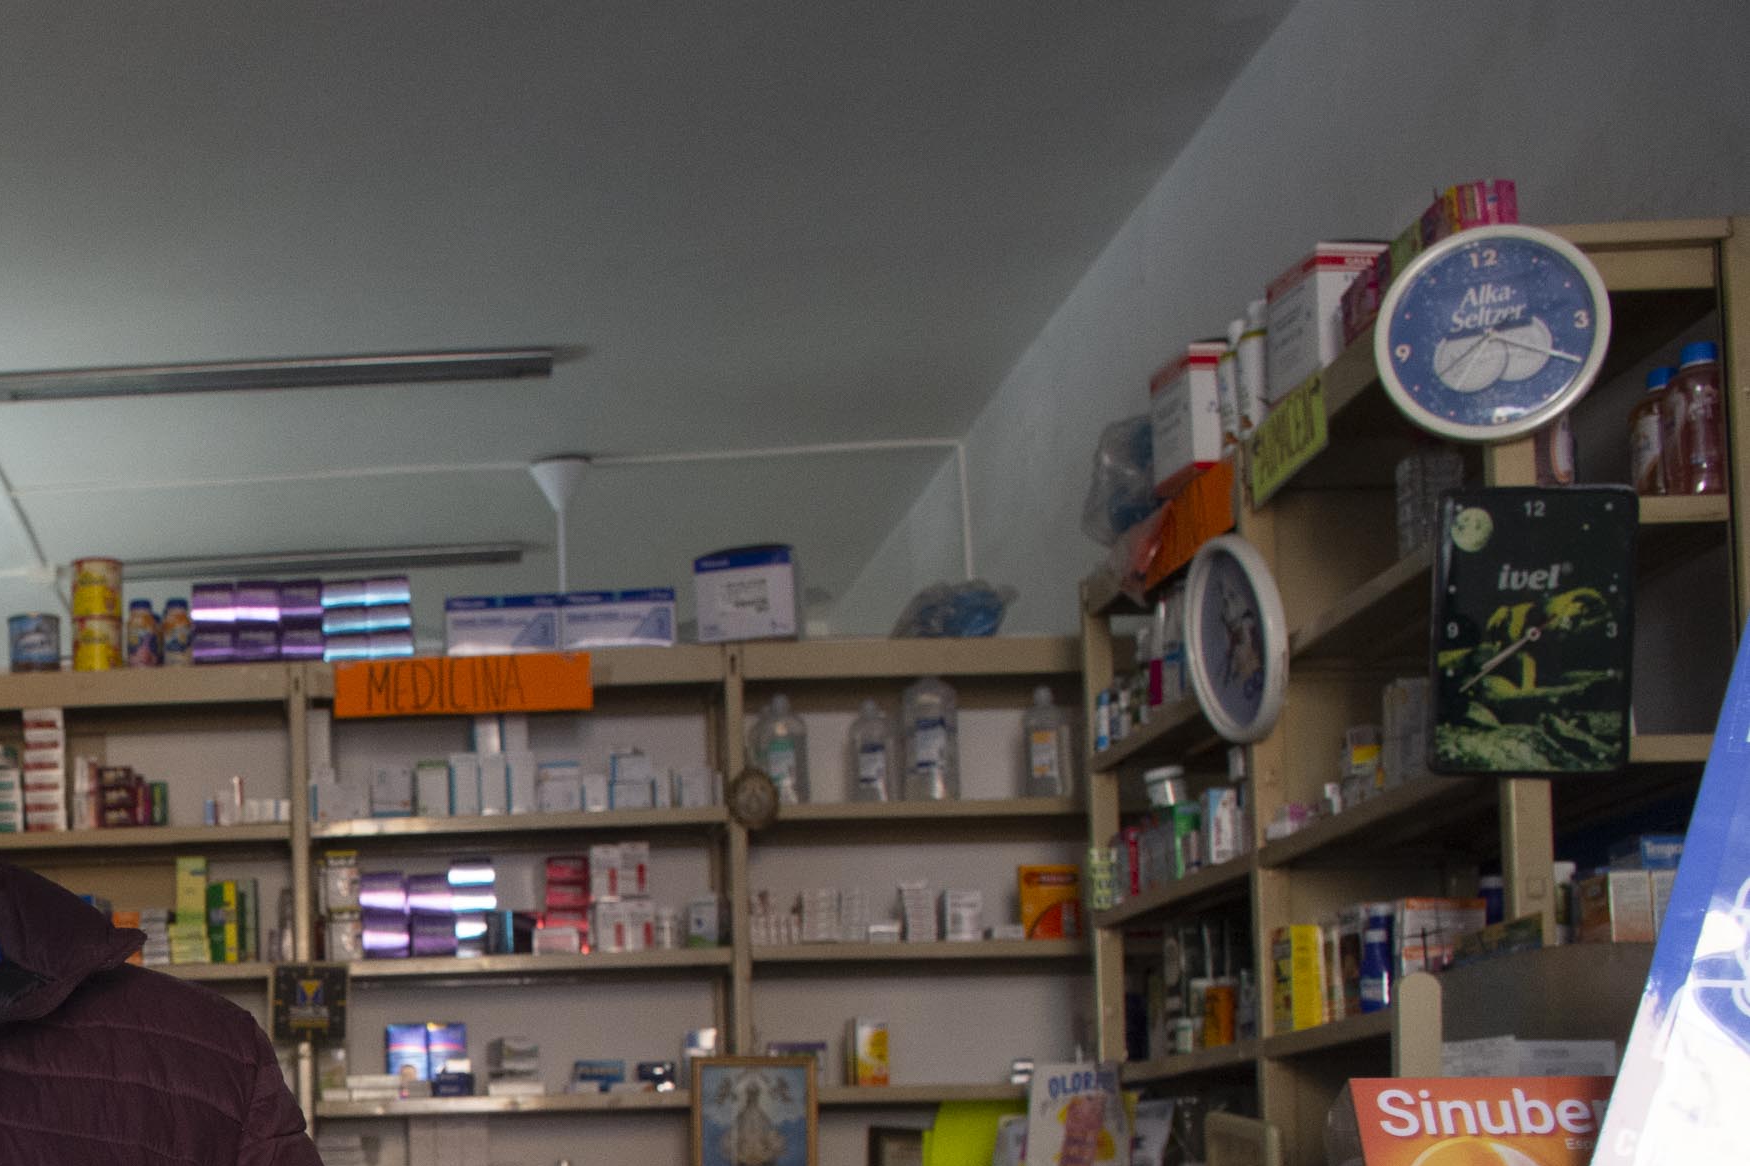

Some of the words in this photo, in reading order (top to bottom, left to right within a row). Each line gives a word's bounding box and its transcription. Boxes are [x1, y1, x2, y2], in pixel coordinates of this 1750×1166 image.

[1470, 252, 1498, 269] 12
[1451, 302, 1527, 333] Seltzer
[1574, 311, 1590, 328] 3
[1395, 345, 1410, 362] 9
[1524, 501, 1546, 517] 12
[1498, 563, 1561, 591] ivel
[1447, 623, 1459, 639] 9
[1606, 623, 1618, 638] 3
[366, 655, 525, 712] MEDICINA
